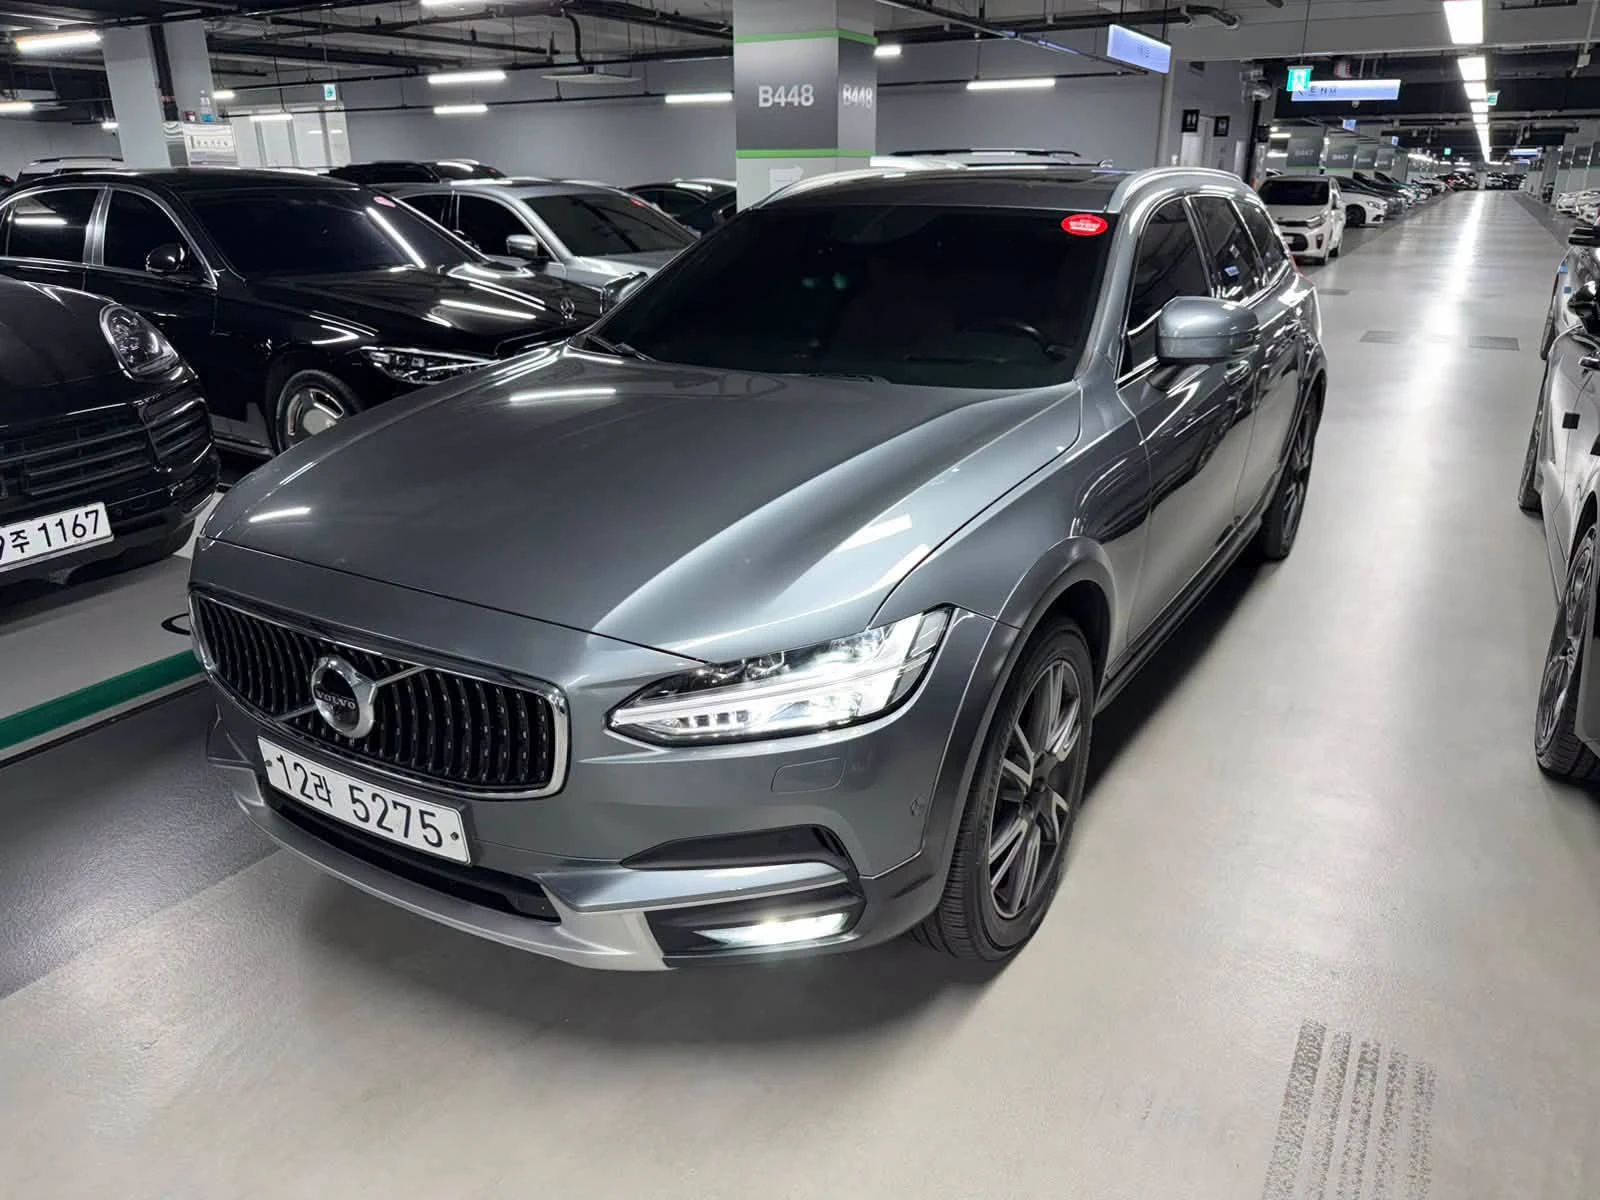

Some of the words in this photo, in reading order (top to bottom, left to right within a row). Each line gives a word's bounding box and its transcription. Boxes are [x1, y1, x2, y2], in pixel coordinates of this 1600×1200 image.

[758, 84, 814, 107] B448
[842, 84, 873, 108] B448
[0, 529, 30, 561] 주
[37, 509, 99, 547] 1167
[315, 689, 356, 710] VOLVO
[276, 754, 333, 808] 12라
[348, 783, 443, 848] 5275
